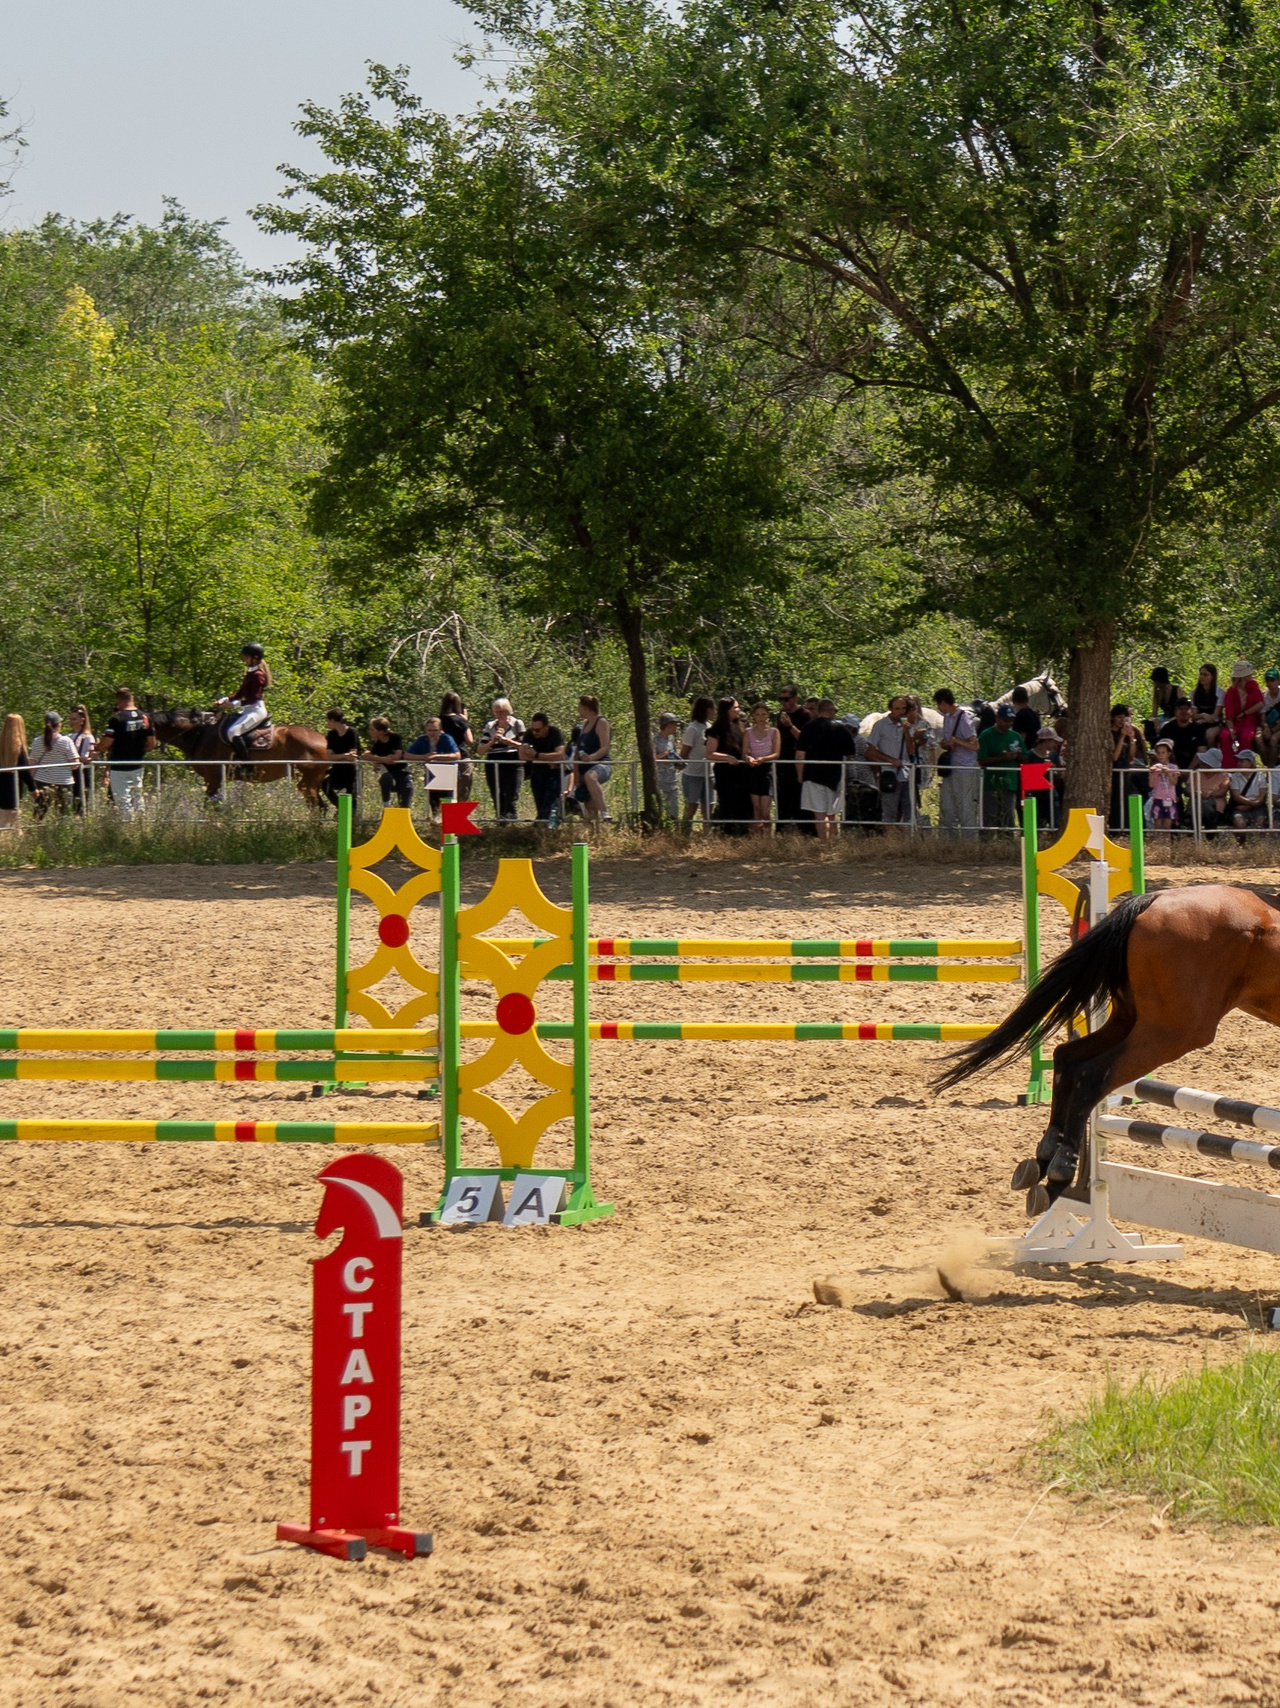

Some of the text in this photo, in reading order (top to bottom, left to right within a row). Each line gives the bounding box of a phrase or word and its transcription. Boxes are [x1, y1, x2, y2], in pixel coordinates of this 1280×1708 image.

[457, 1187, 545, 1218] 5 A
[341, 1256, 374, 1477] СТАРТ
